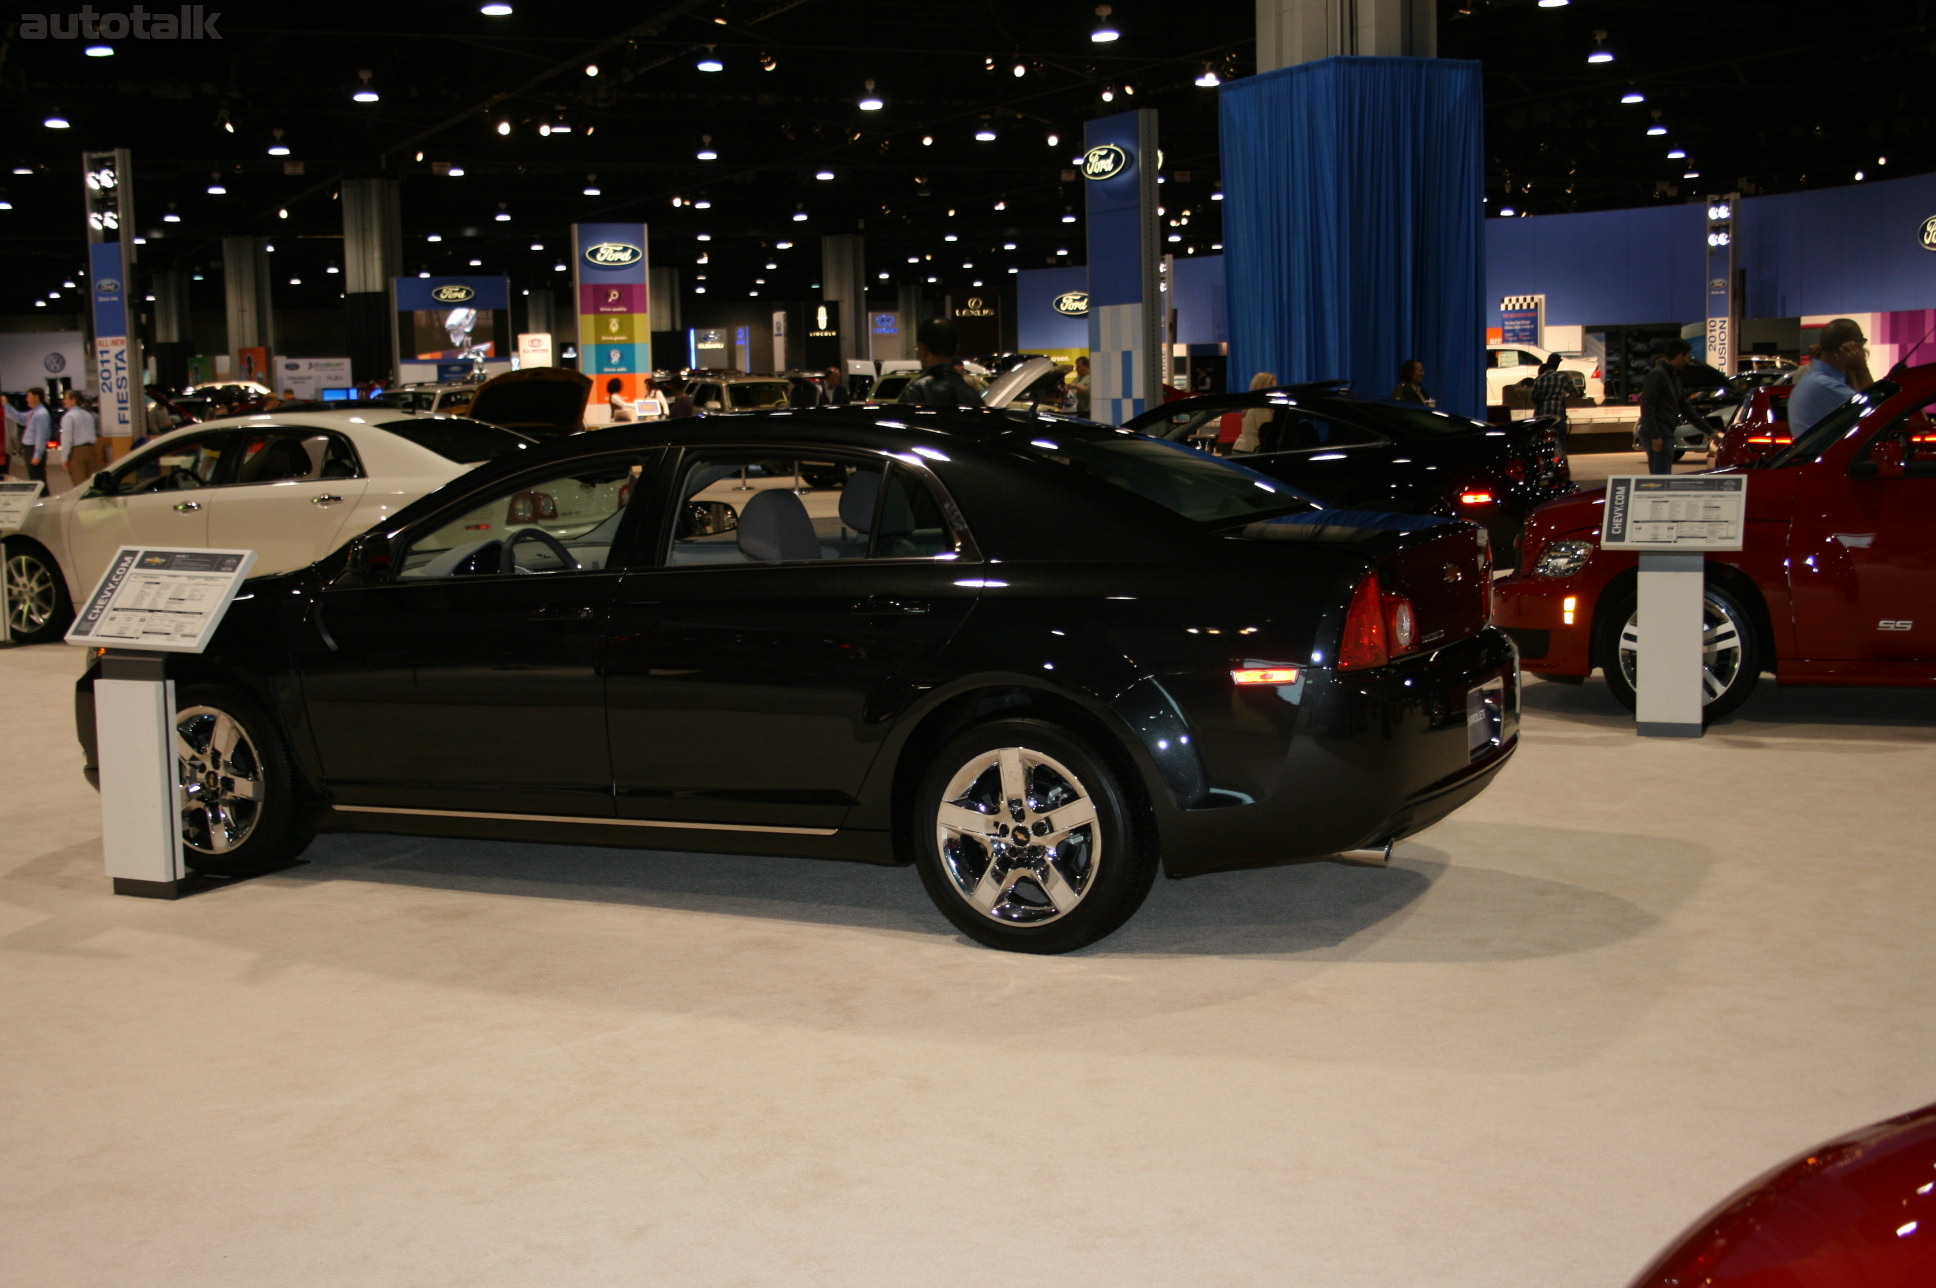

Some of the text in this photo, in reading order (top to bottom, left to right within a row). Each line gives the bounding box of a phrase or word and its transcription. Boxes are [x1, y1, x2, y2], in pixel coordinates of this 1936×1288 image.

[1086, 149, 1115, 174] Ford
[596, 246, 632, 262] Ford
[439, 288, 467, 299] Ford
[1060, 295, 1088, 311] Ford
[1708, 319, 1717, 352] 2010
[1718, 319, 1727, 373] FUSION
[99, 349, 113, 393] 2011
[114, 349, 130, 425] FIESTA
[1611, 486, 1626, 535] CHEVY.COM
[87, 555, 134, 621] CHEVY.COM
[1877, 620, 1913, 631] SS
